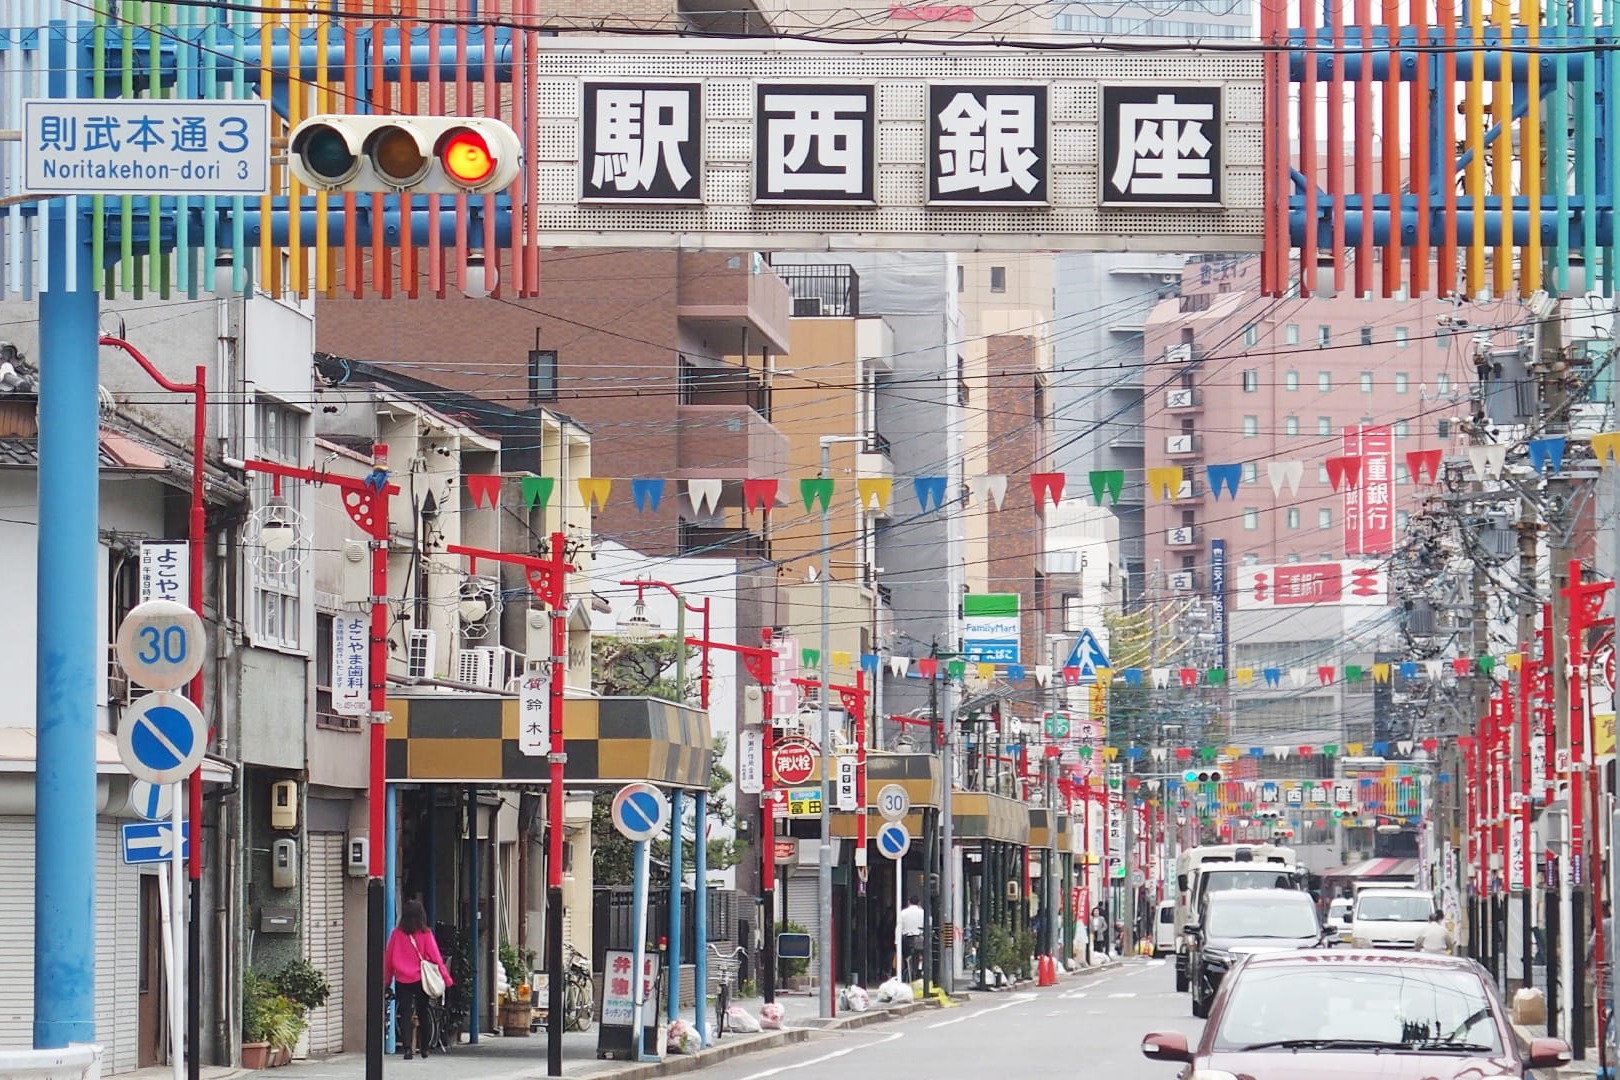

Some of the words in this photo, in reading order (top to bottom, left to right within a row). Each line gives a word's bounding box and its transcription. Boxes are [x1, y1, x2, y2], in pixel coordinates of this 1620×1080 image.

[591, 88, 1214, 195] 駅西銀座
[42, 158, 221, 181] Noritakehon-dori
[237, 159, 249, 180] 3
[1366, 432, 1389, 531] 三重銀行
[1279, 573, 1324, 598] 三重銀行
[966, 623, 1017, 633] FamilyMart
[138, 625, 187, 664] 30
[347, 617, 364, 689] よこやま歯科
[527, 678, 542, 691] 質
[526, 698, 543, 735] 鈴木
[777, 754, 811, 772] 消火栓
[790, 800, 822, 814] 富田
[885, 795, 903, 811] 30
